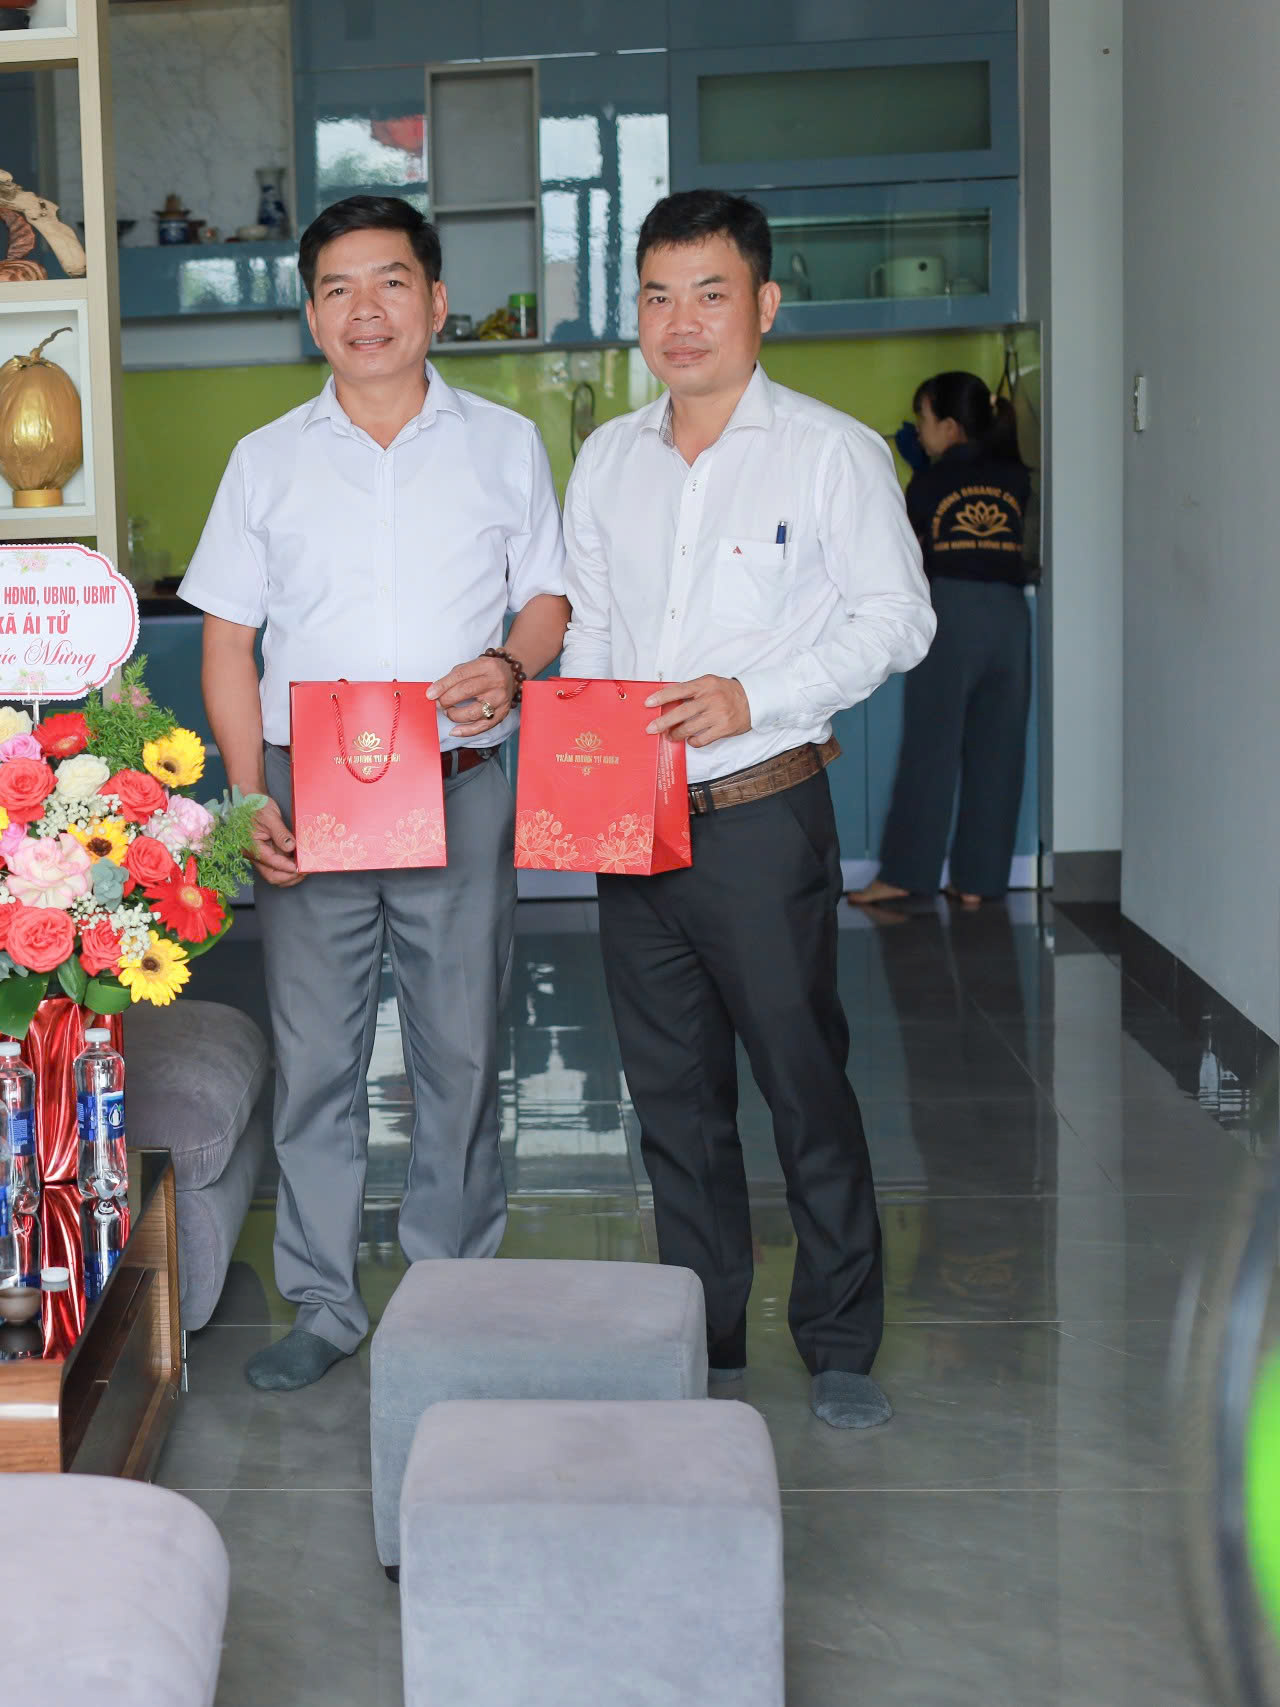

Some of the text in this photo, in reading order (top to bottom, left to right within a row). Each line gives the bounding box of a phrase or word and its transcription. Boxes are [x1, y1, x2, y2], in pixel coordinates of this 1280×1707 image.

[4, 585, 40, 606] HĐND,
[44, 585, 80, 606] UBND,
[83, 585, 117, 605] UBMT
[22, 612, 41, 635] ÁI
[46, 609, 71, 635] TỬ
[23, 638, 98, 678] Mừng
